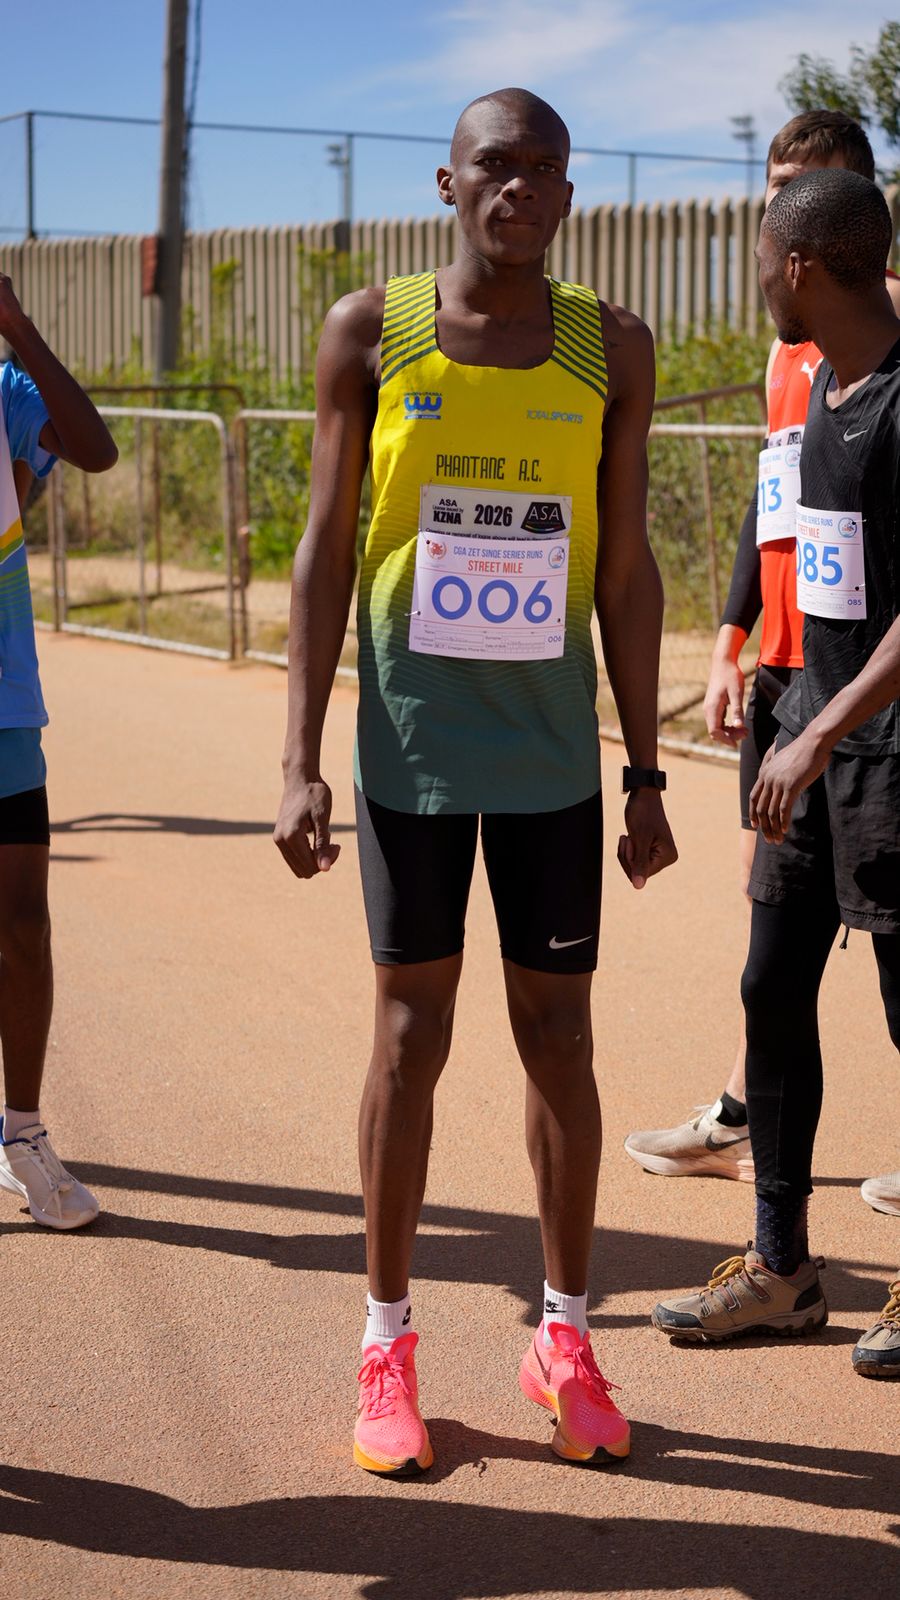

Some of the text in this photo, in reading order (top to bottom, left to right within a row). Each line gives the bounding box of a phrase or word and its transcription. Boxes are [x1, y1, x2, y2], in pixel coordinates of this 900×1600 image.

[526, 409, 583, 425] TOTALSPORTS
[436, 454, 542, 482] PHANTANE A.C.
[439, 498, 458, 507] ASA
[757, 477, 782, 516] 13
[432, 510, 462, 525] KZNA
[474, 503, 513, 527] 2026
[528, 505, 560, 521] ASA
[502, 549, 525, 560] SERIES
[526, 550, 543, 560] RUNS
[468, 560, 523, 574] STREET MILE
[431, 575, 553, 624] 006
